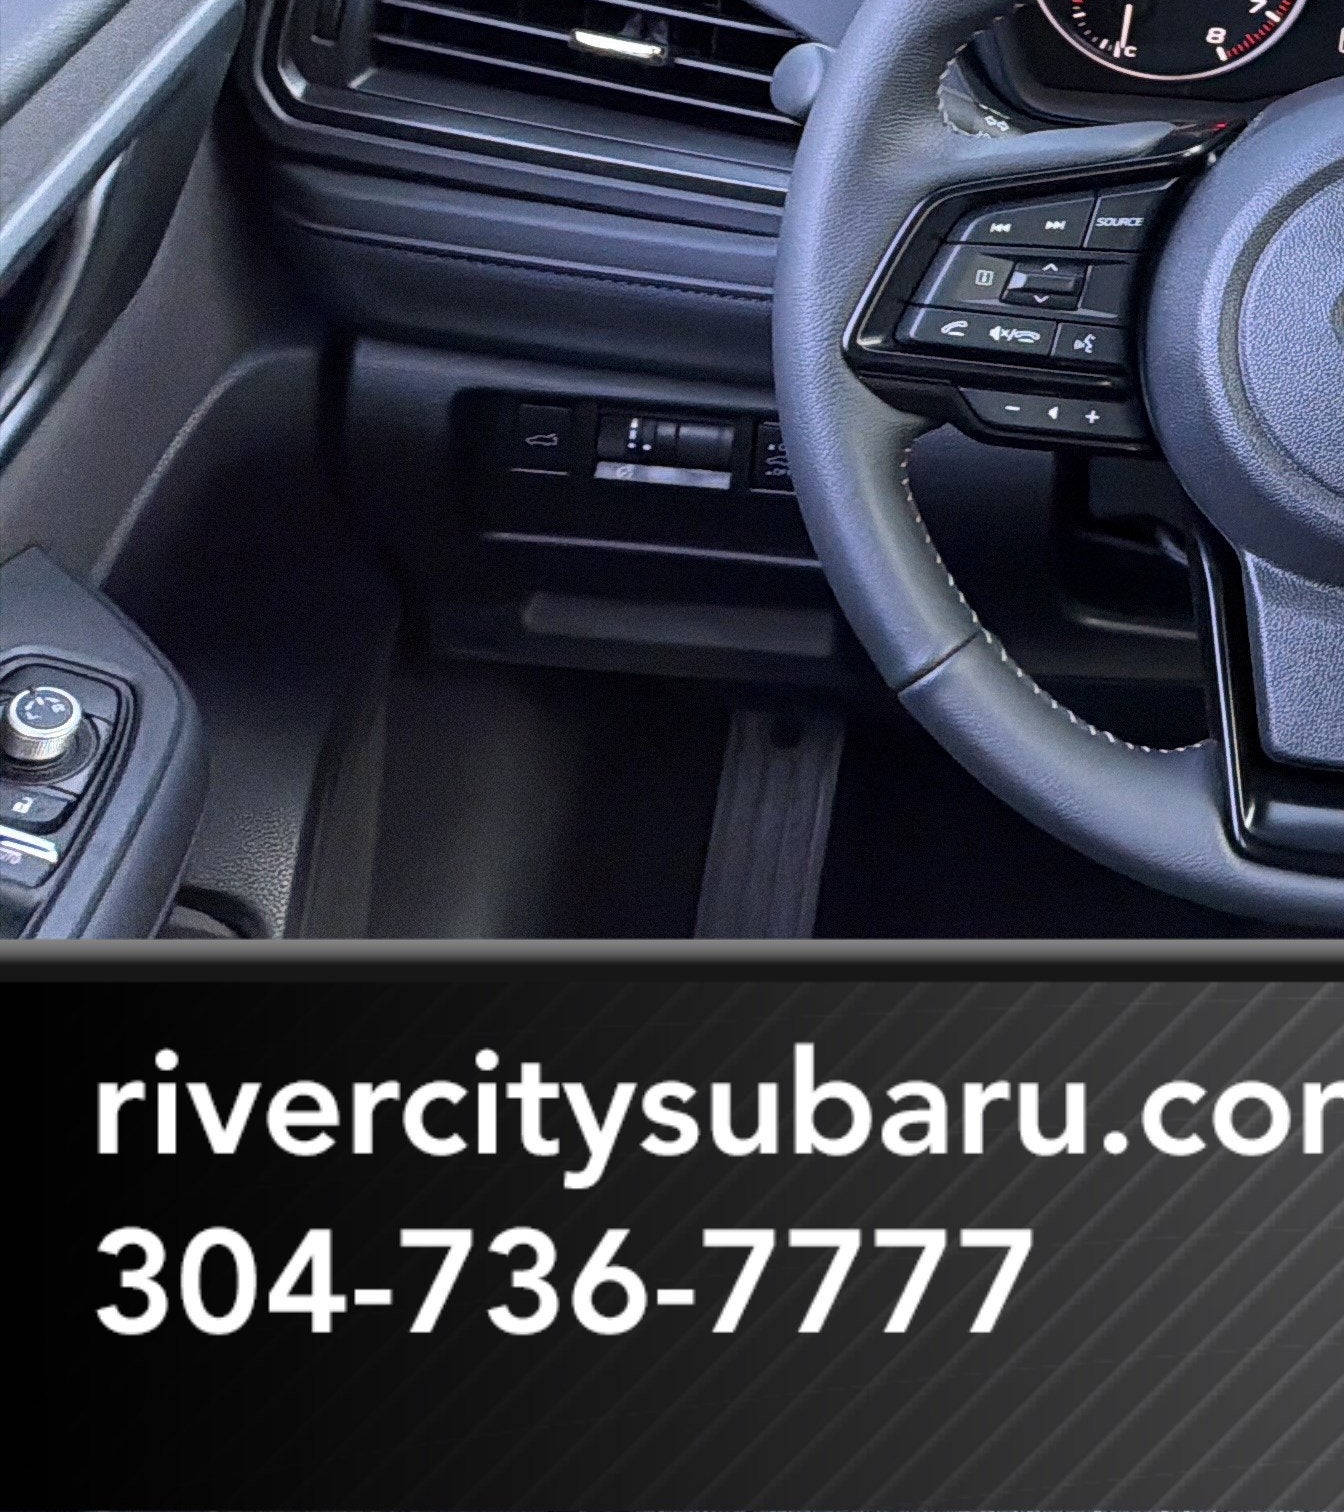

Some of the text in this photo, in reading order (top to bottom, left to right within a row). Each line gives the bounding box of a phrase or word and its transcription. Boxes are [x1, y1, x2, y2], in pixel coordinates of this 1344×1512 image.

[1205, 27, 1227, 44] 8
[1123, 46, 1137, 58] C
[1095, 216, 1145, 228] SOURCE
